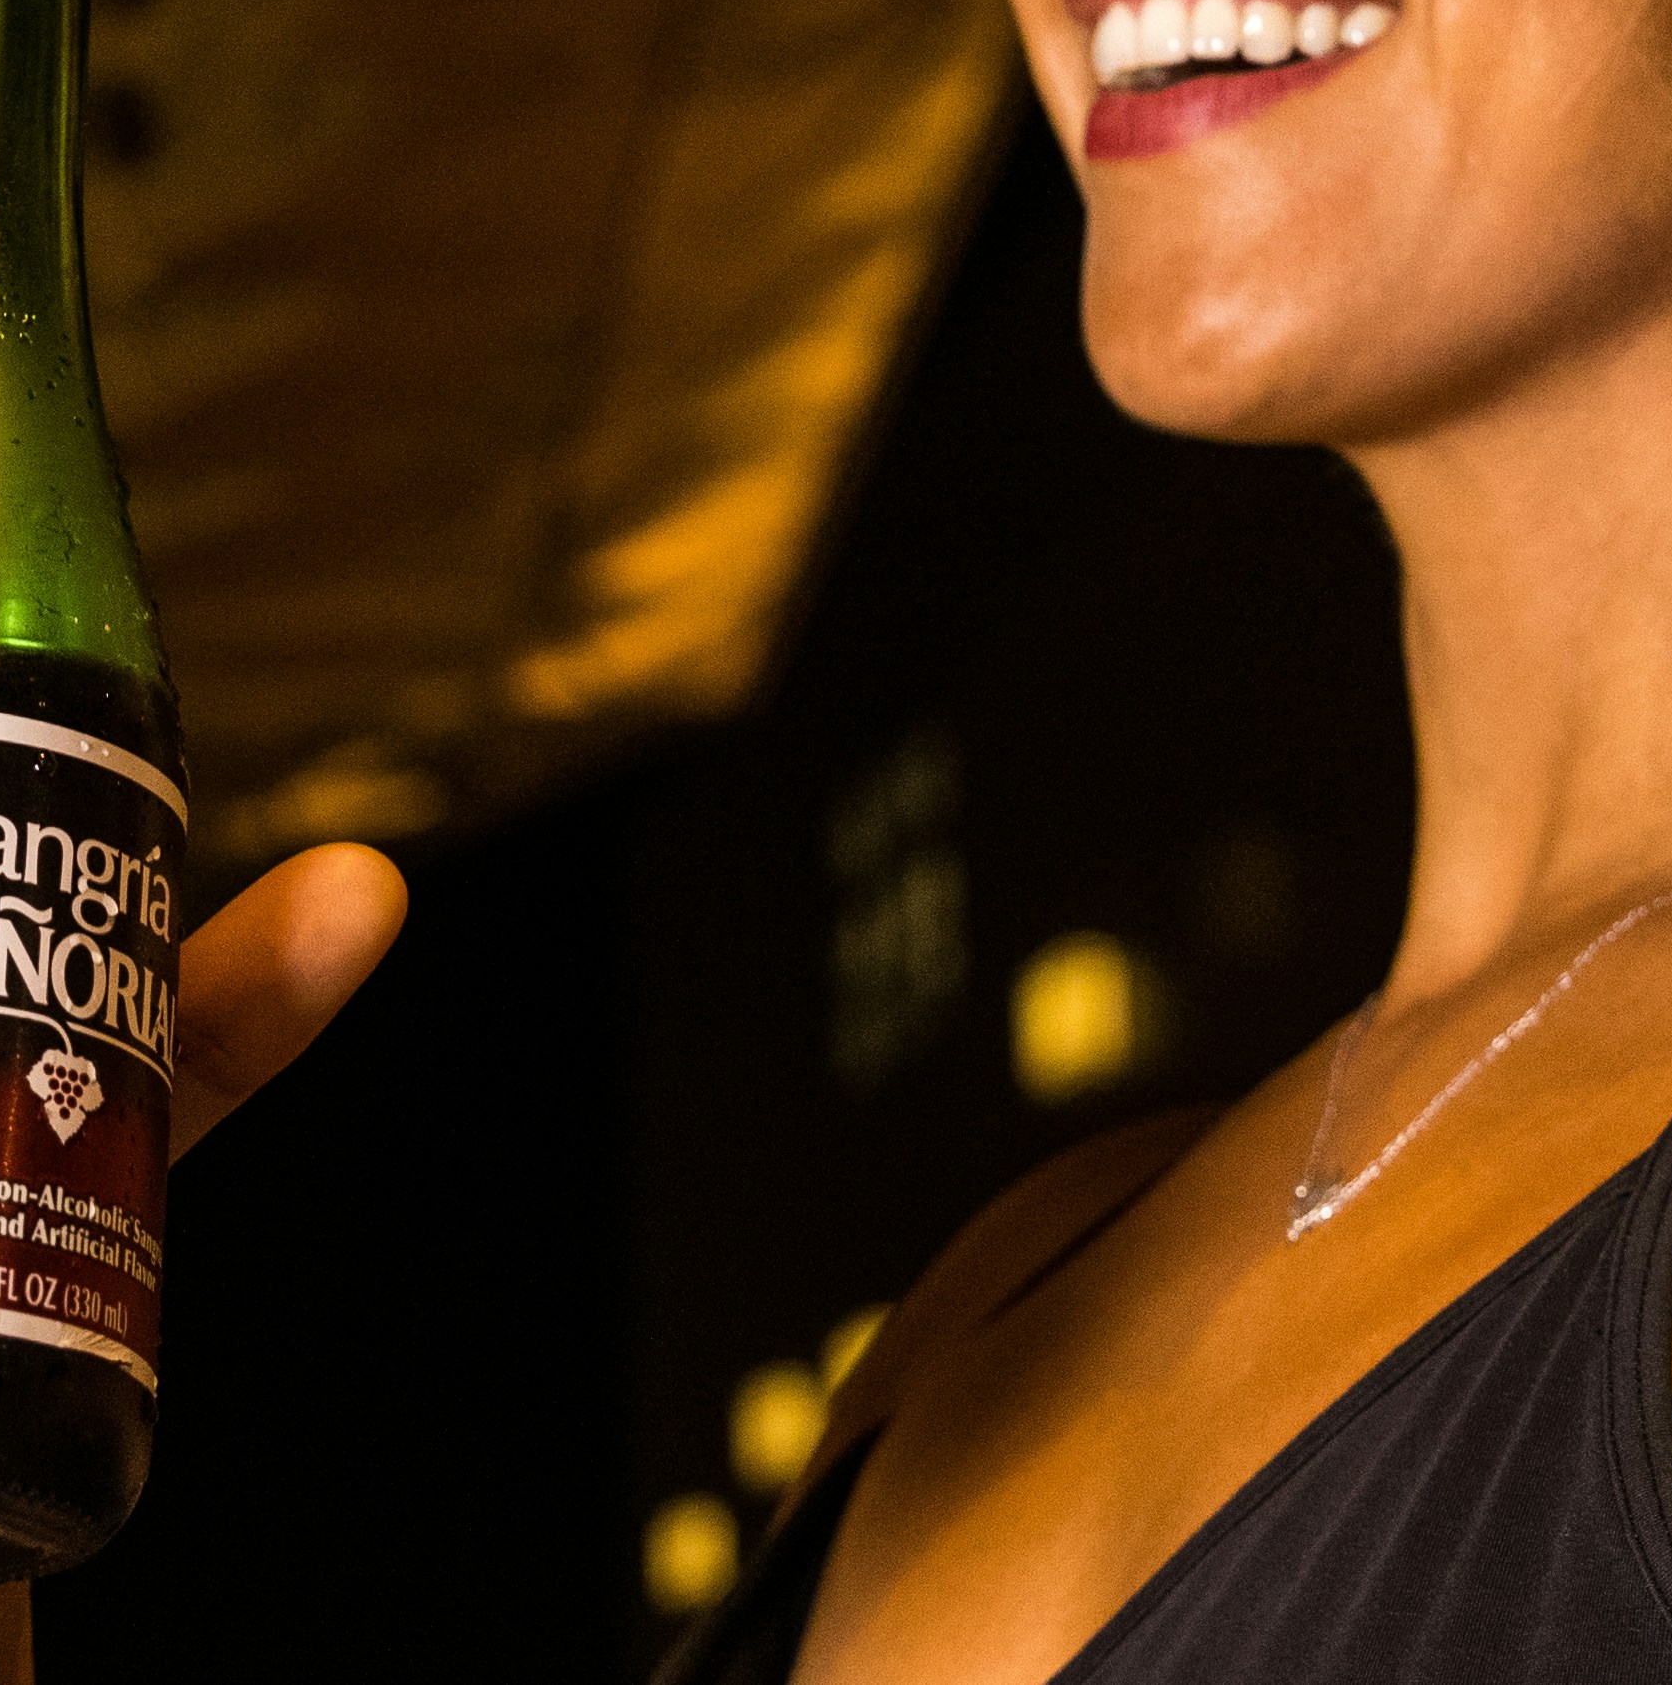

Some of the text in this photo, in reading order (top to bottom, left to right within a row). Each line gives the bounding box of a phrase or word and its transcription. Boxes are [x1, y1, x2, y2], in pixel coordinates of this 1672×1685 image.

[31, 1217, 121, 1268] Artificial
[24, 1271, 59, 1311] OZ
[63, 1282, 102, 1323] (330
[104, 1300, 129, 1339] mL)
